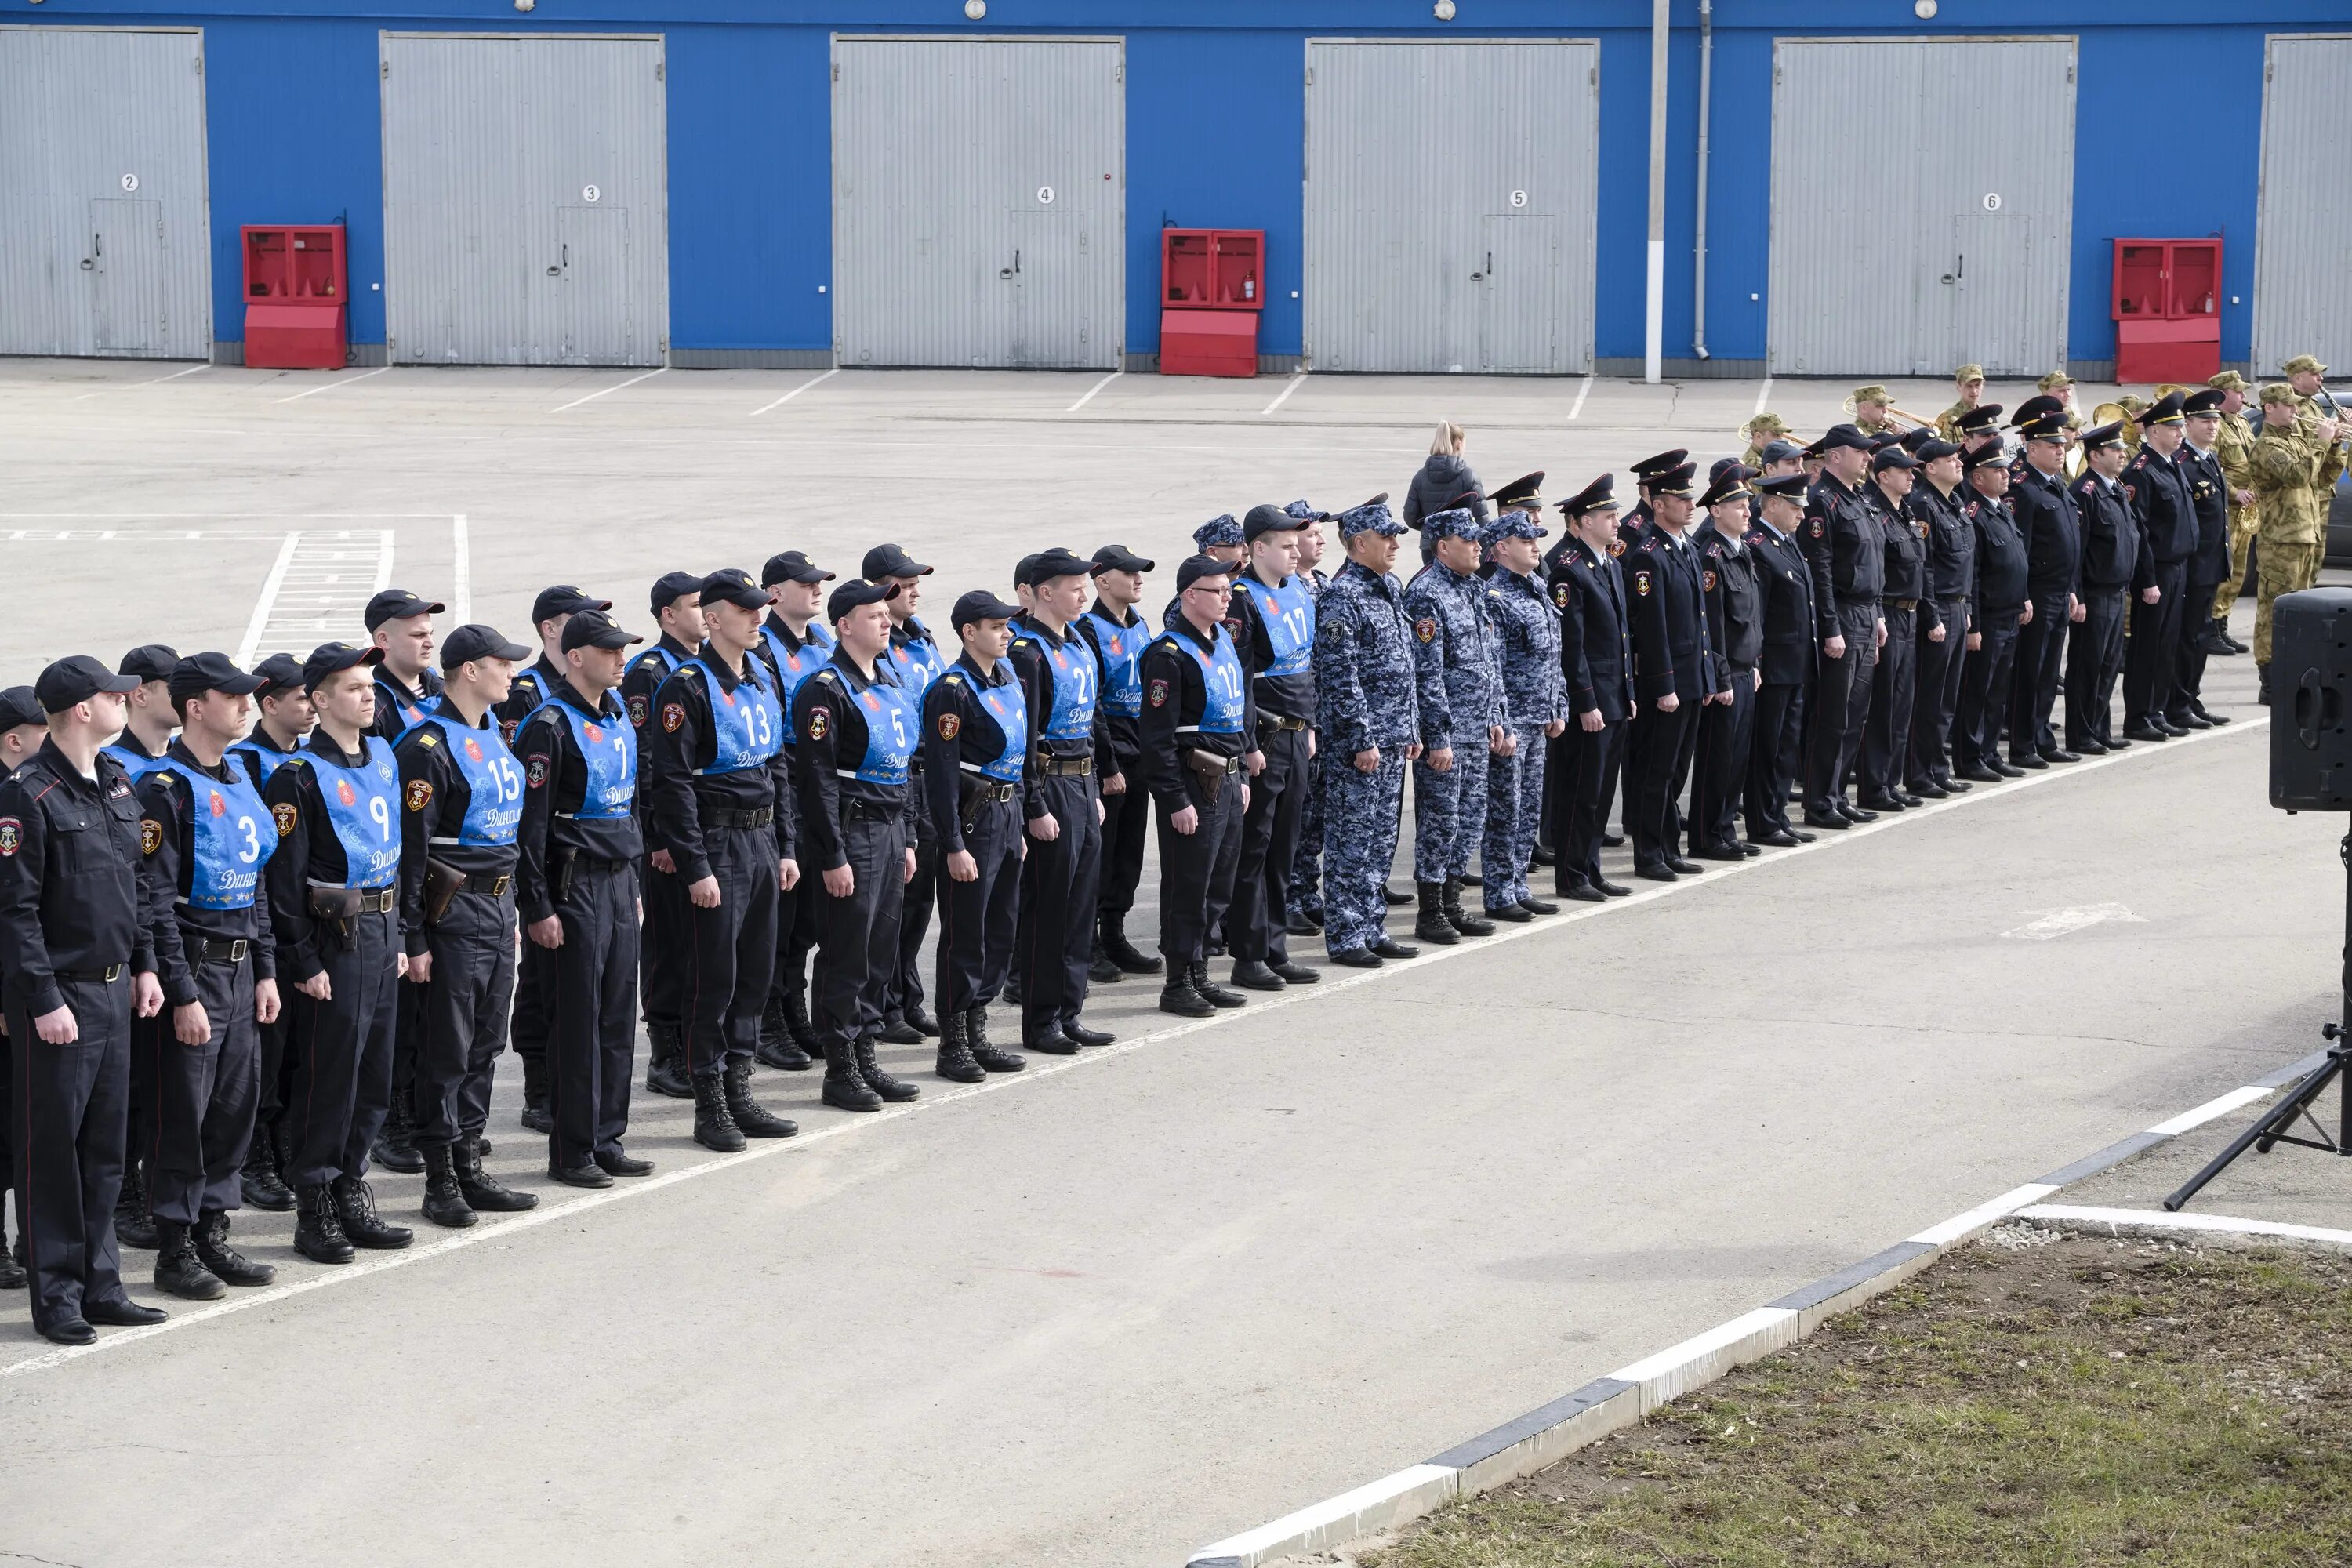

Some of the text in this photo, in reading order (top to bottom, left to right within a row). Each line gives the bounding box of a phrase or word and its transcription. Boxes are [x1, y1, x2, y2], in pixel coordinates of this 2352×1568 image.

[126, 176, 133, 188] 2
[588, 187, 594, 200] 3
[1041, 189, 1050, 201] 4
[1515, 192, 1523, 205] 5
[1988, 195, 1996, 208] 6
[1283, 607, 1308, 645] 17
[1073, 664, 1096, 705] 21
[1127, 651, 1141, 686] 1
[1217, 662, 1241, 699] 12
[740, 703, 771, 747] 13
[891, 708, 906, 748] 5
[613, 736, 627, 780] 7
[488, 757, 520, 804] 15
[369, 795, 390, 843] 9
[238, 815, 260, 863] 3
